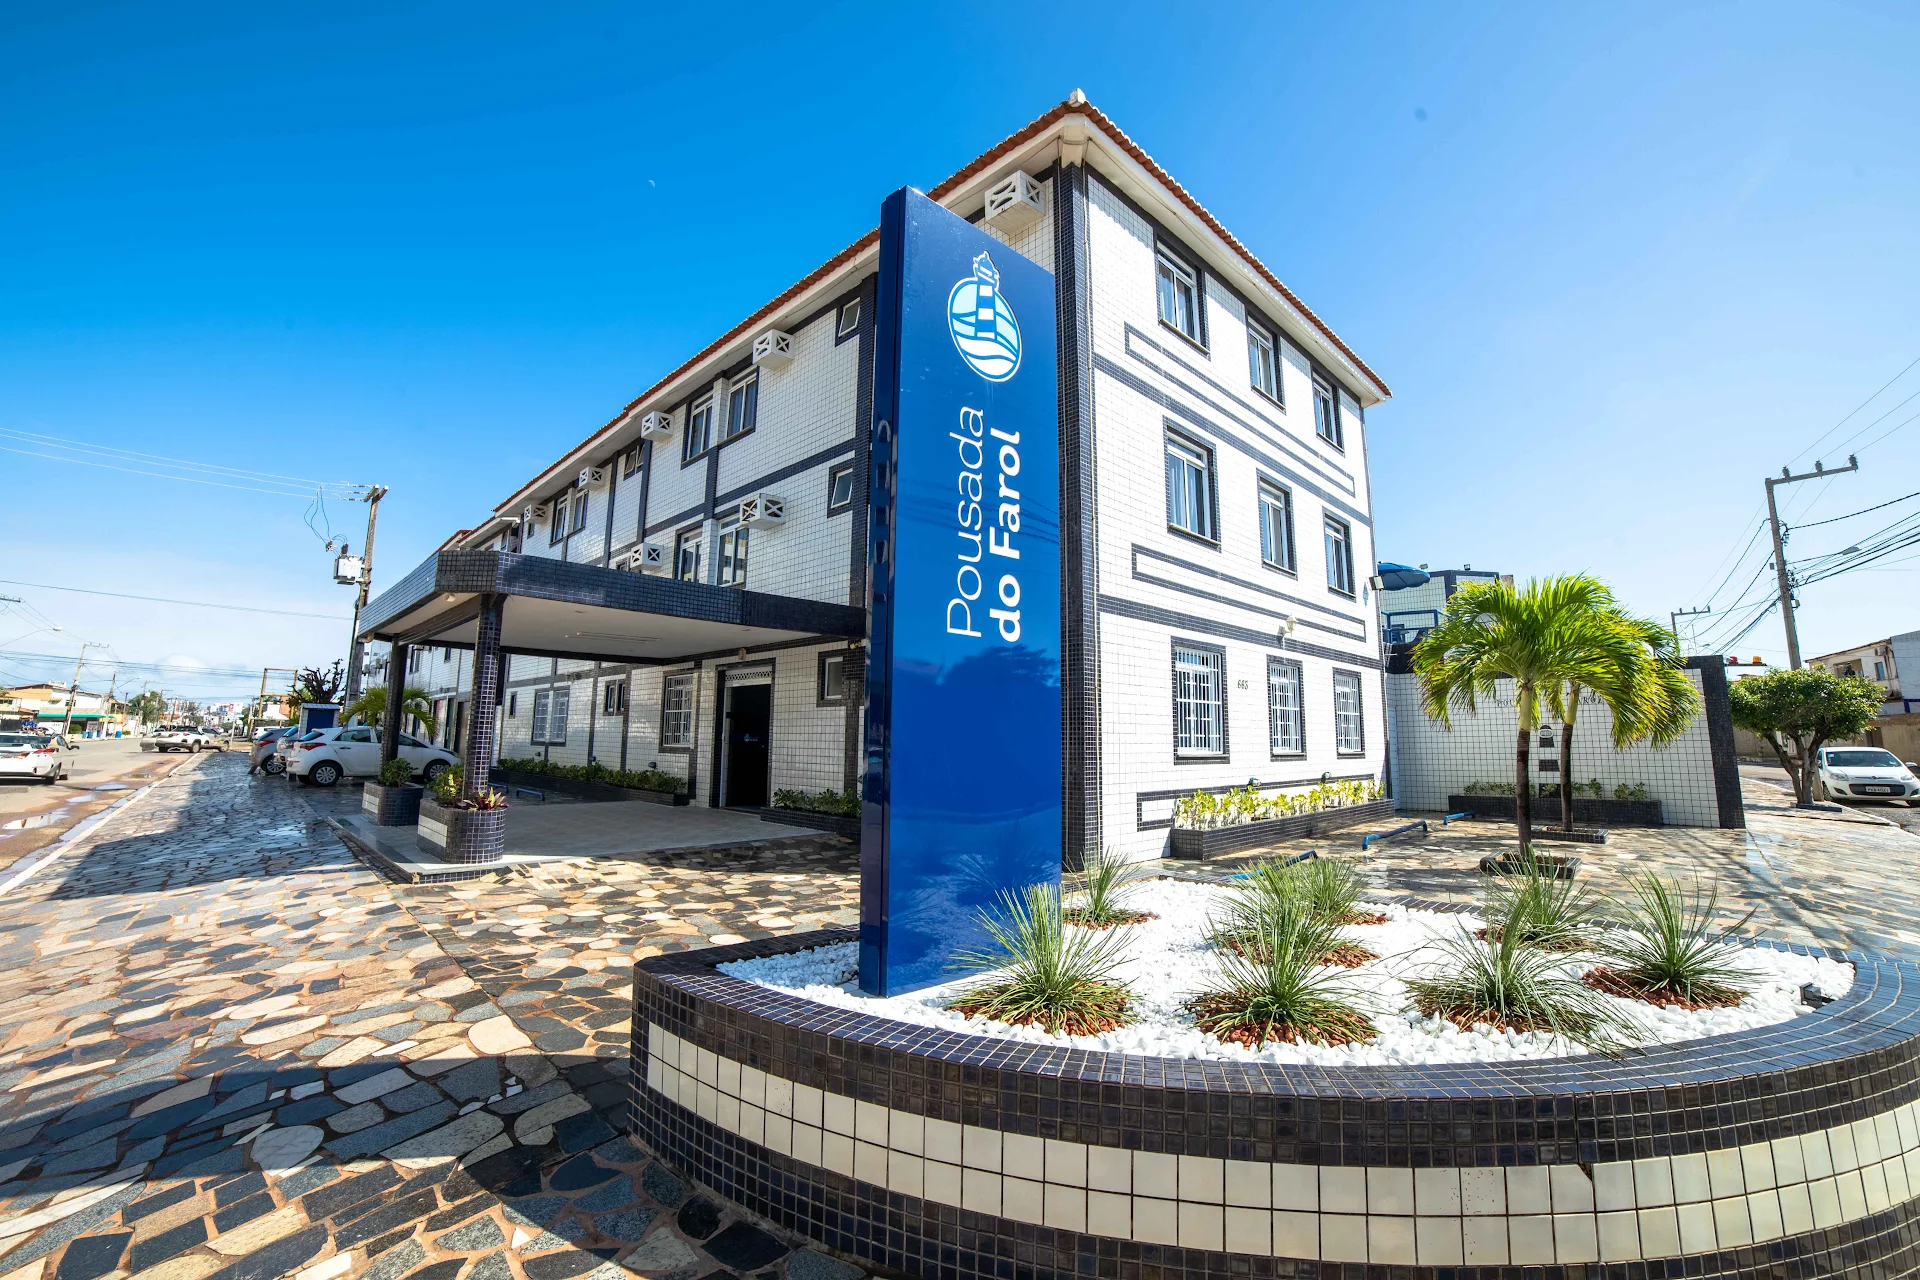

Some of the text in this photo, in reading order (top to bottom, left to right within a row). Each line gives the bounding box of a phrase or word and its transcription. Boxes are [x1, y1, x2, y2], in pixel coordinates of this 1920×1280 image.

[946, 406, 983, 638] Pousada
[989, 427, 1021, 643] do Farol
